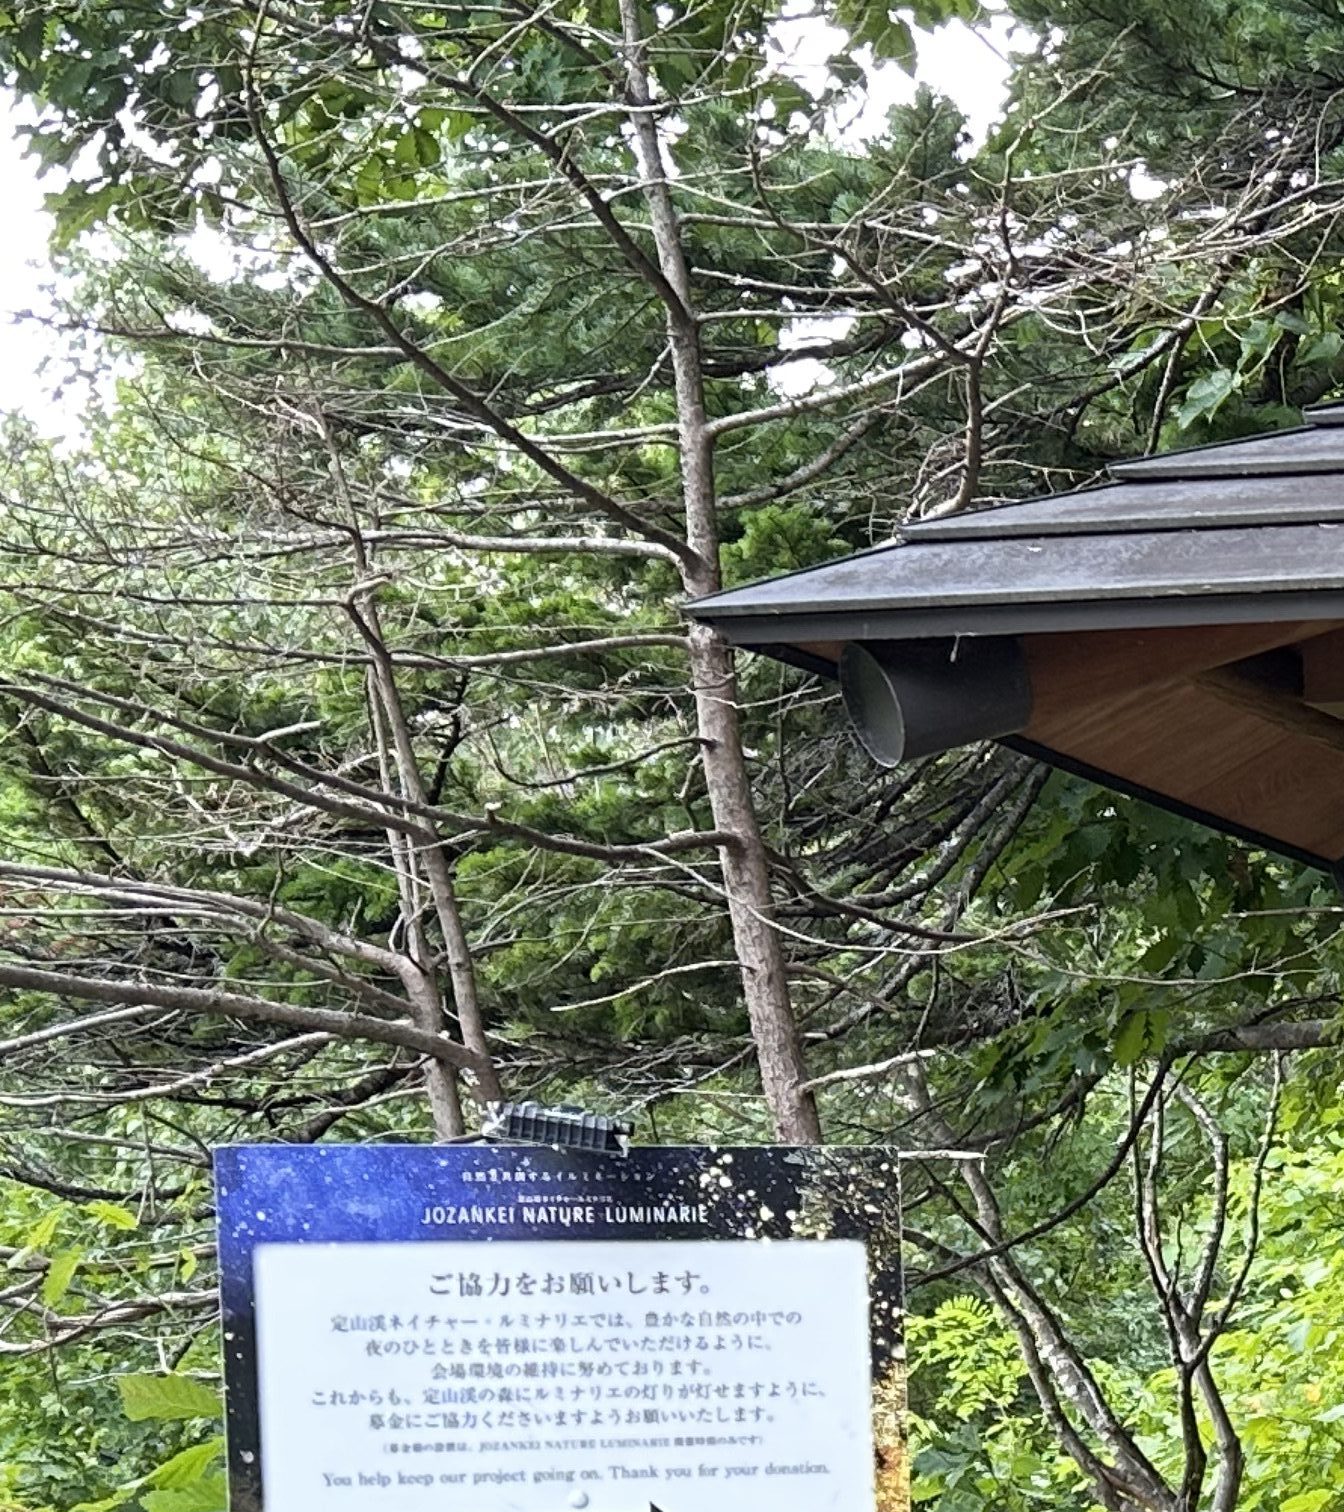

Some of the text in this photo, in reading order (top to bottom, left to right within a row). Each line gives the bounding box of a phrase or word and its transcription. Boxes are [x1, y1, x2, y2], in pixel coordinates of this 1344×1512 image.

[421, 1202, 709, 1226] JOZANKEI NATURE LUMINARIE
[429, 1271, 711, 1297] ご協力をお願いします。
[329, 1311, 803, 1333] 定山渓ネイチャー・ルミナリエでは、豊かな自然の中での
[365, 1334, 773, 1357] 夜のひとときを皆様に楽しんでいただけるように、
[430, 1359, 712, 1381] 会場環境の維持に努めております。
[369, 1406, 776, 1431] 募金にご協力くださいますようお願いいたします。
[478, 1439, 541, 1453] JOZANKEI
[544, 1437, 597, 1451] NATURE
[600, 1437, 671, 1450] LUMINARIE
[322, 1472, 353, 1487] You
[358, 1471, 391, 1488] help
[397, 1471, 434, 1486] keep
[439, 1473, 467, 1484] our
[473, 1469, 526, 1486] project
[533, 1468, 575, 1483] going
[608, 1465, 658, 1480] Thank
[665, 1467, 692, 1480] you
[698, 1463, 719, 1477] for
[724, 1465, 759, 1479] your
[764, 1461, 831, 1476] donation.
